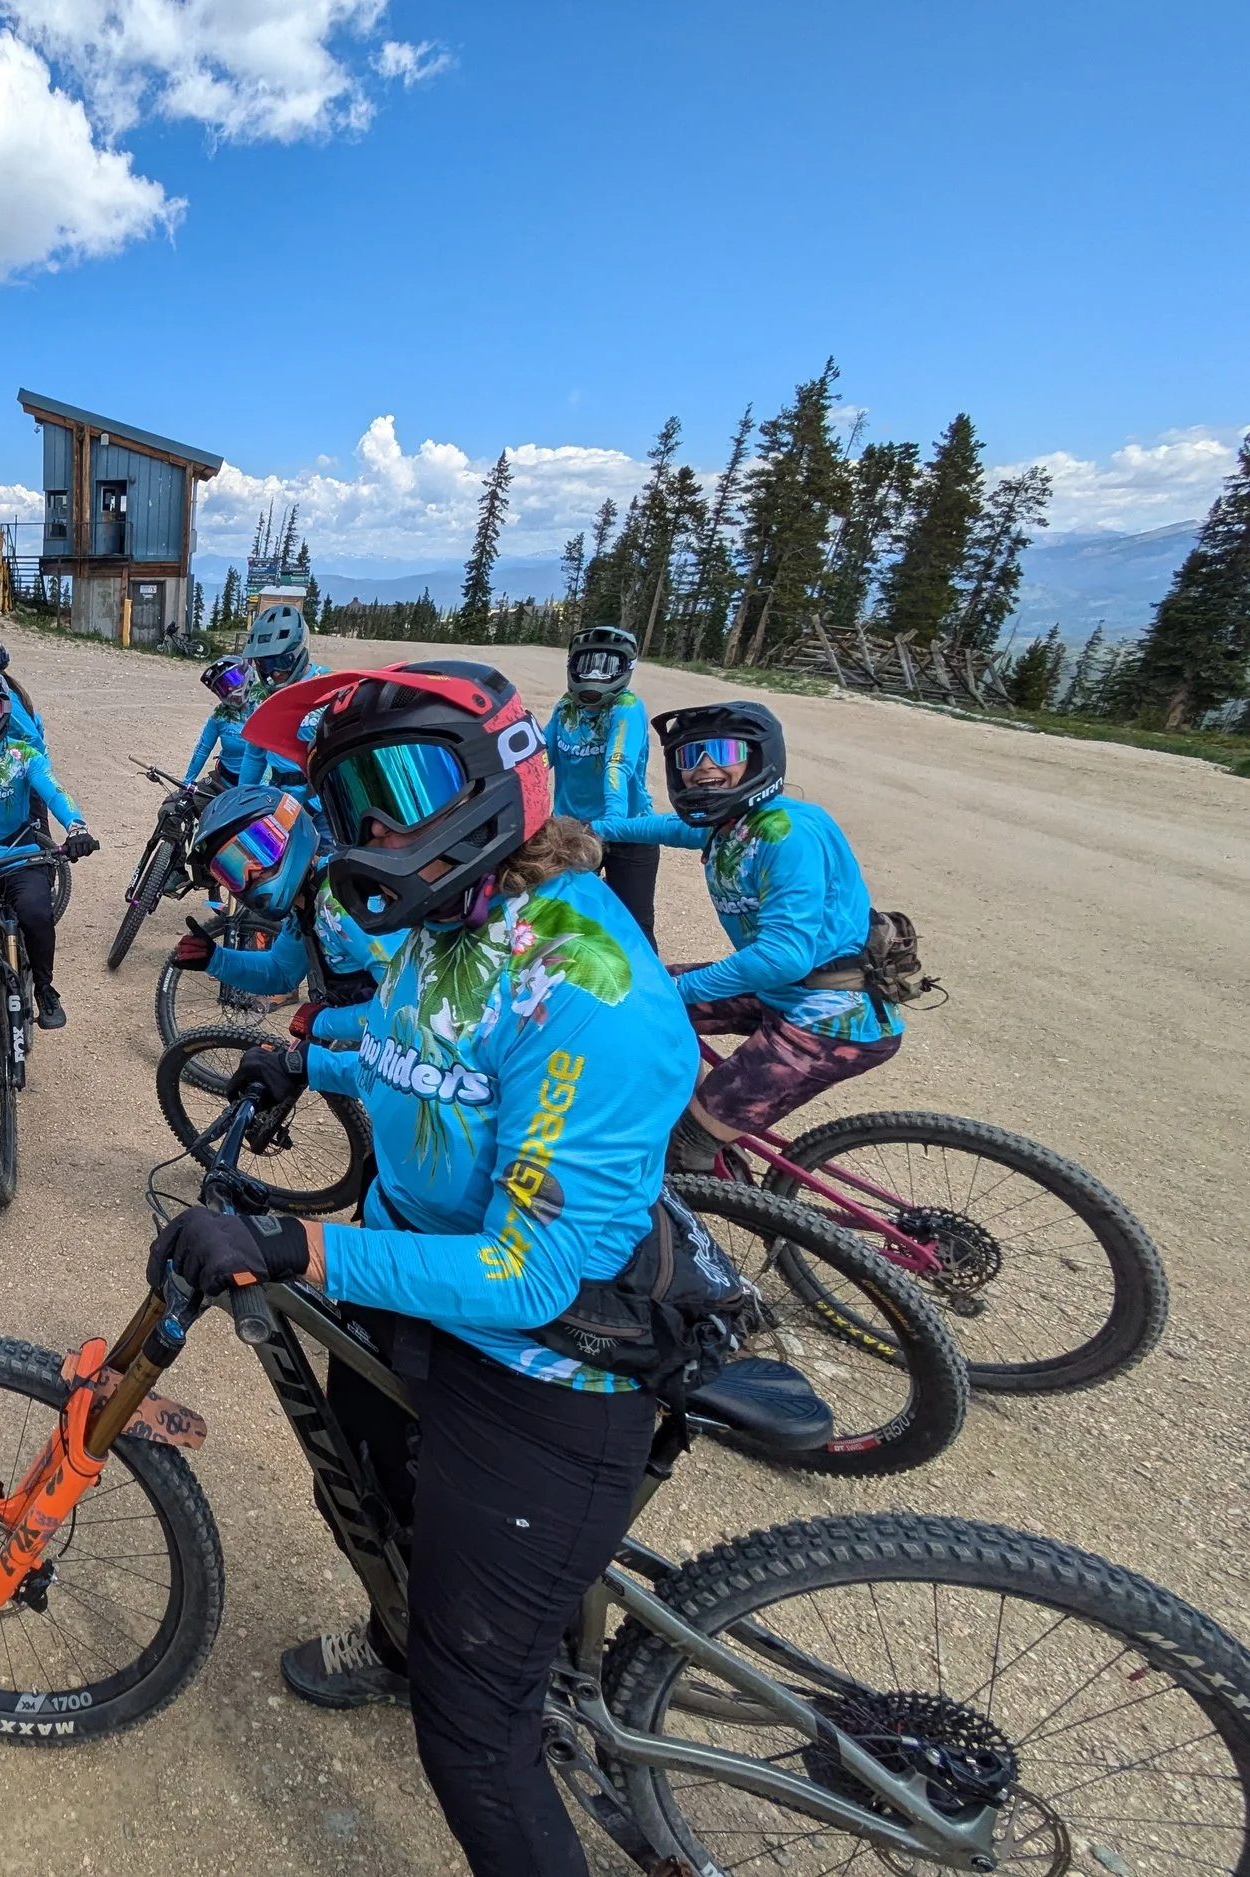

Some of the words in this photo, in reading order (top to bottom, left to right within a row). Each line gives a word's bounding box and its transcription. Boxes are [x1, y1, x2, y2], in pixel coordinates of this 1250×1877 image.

[13, 1026, 25, 1063] FOX
[378, 1037, 492, 1104] Riders
[873, 1414, 911, 1445] FR570
[51, 1691, 93, 1712] 1700
